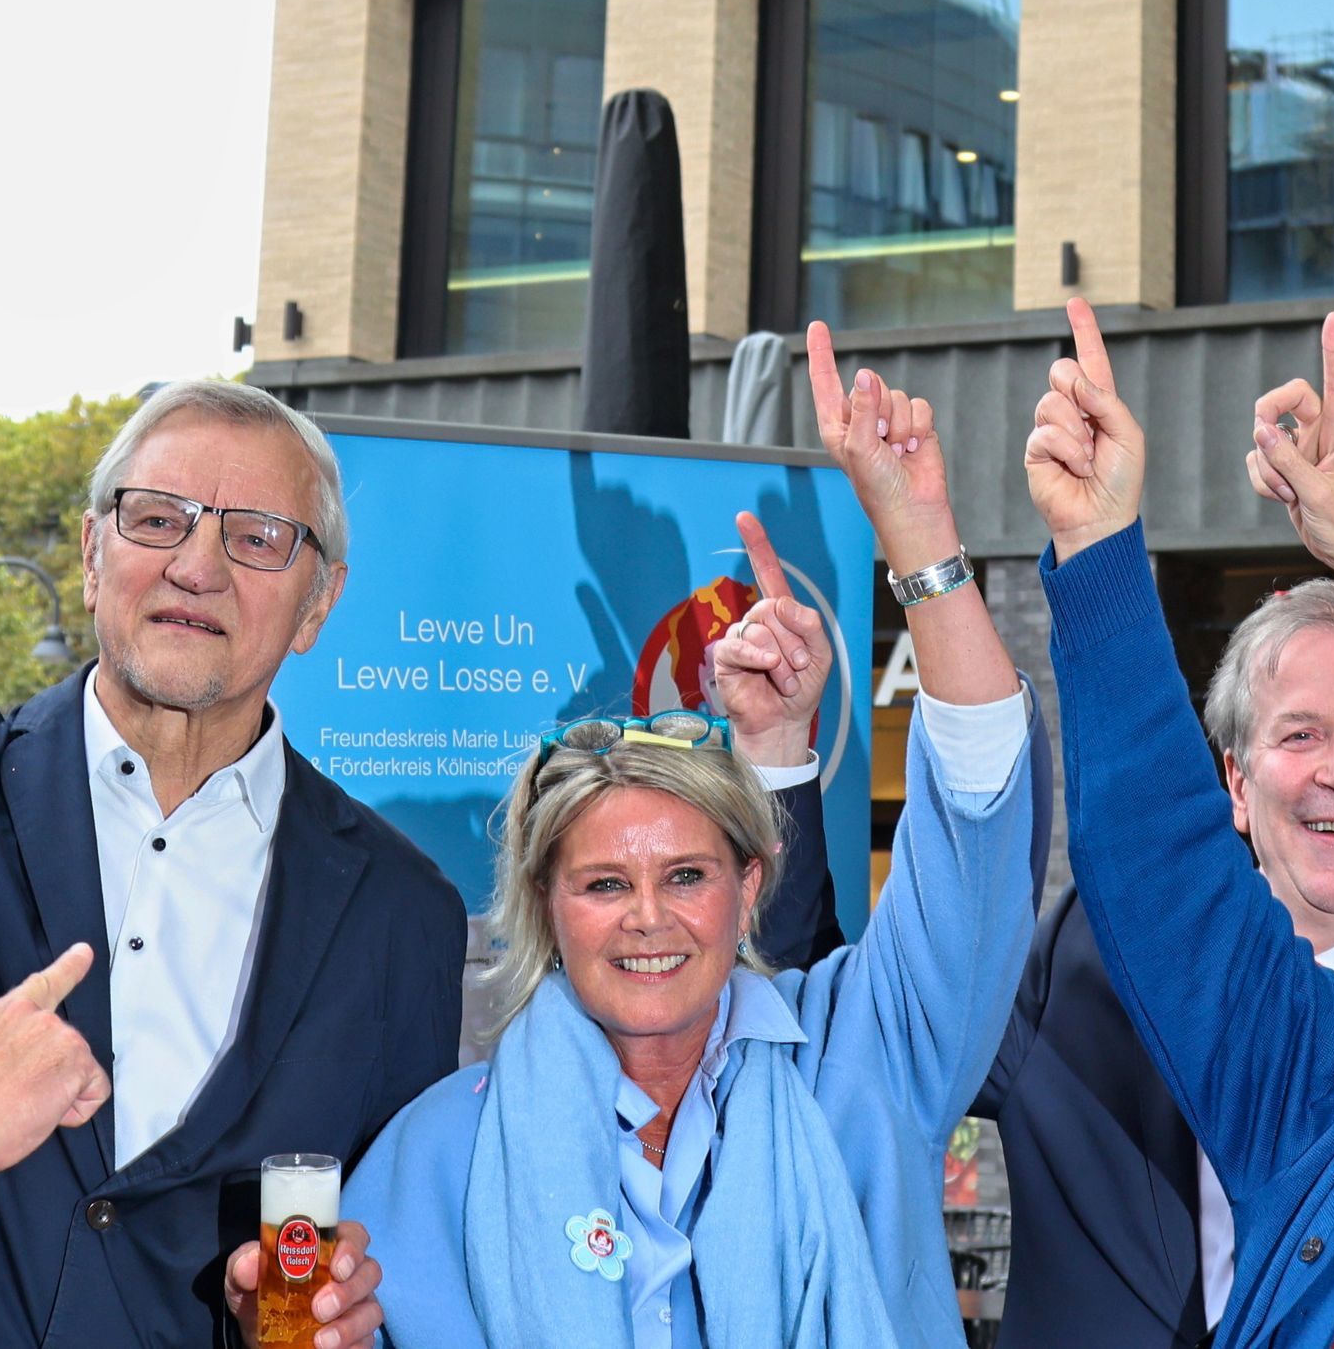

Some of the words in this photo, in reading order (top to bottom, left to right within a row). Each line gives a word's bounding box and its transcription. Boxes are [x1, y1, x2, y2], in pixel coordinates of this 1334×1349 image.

[400, 611, 484, 644] Levve
[494, 614, 534, 646] Un
[338, 658, 428, 690] Levve
[440, 660, 522, 692] Losse
[532, 668, 556, 693] e.
[567, 663, 588, 693] V.
[320, 728, 447, 749] Freundeskreis
[453, 729, 498, 749] Marie
[504, 730, 541, 749] Luis
[330, 757, 432, 777] Förderkreis
